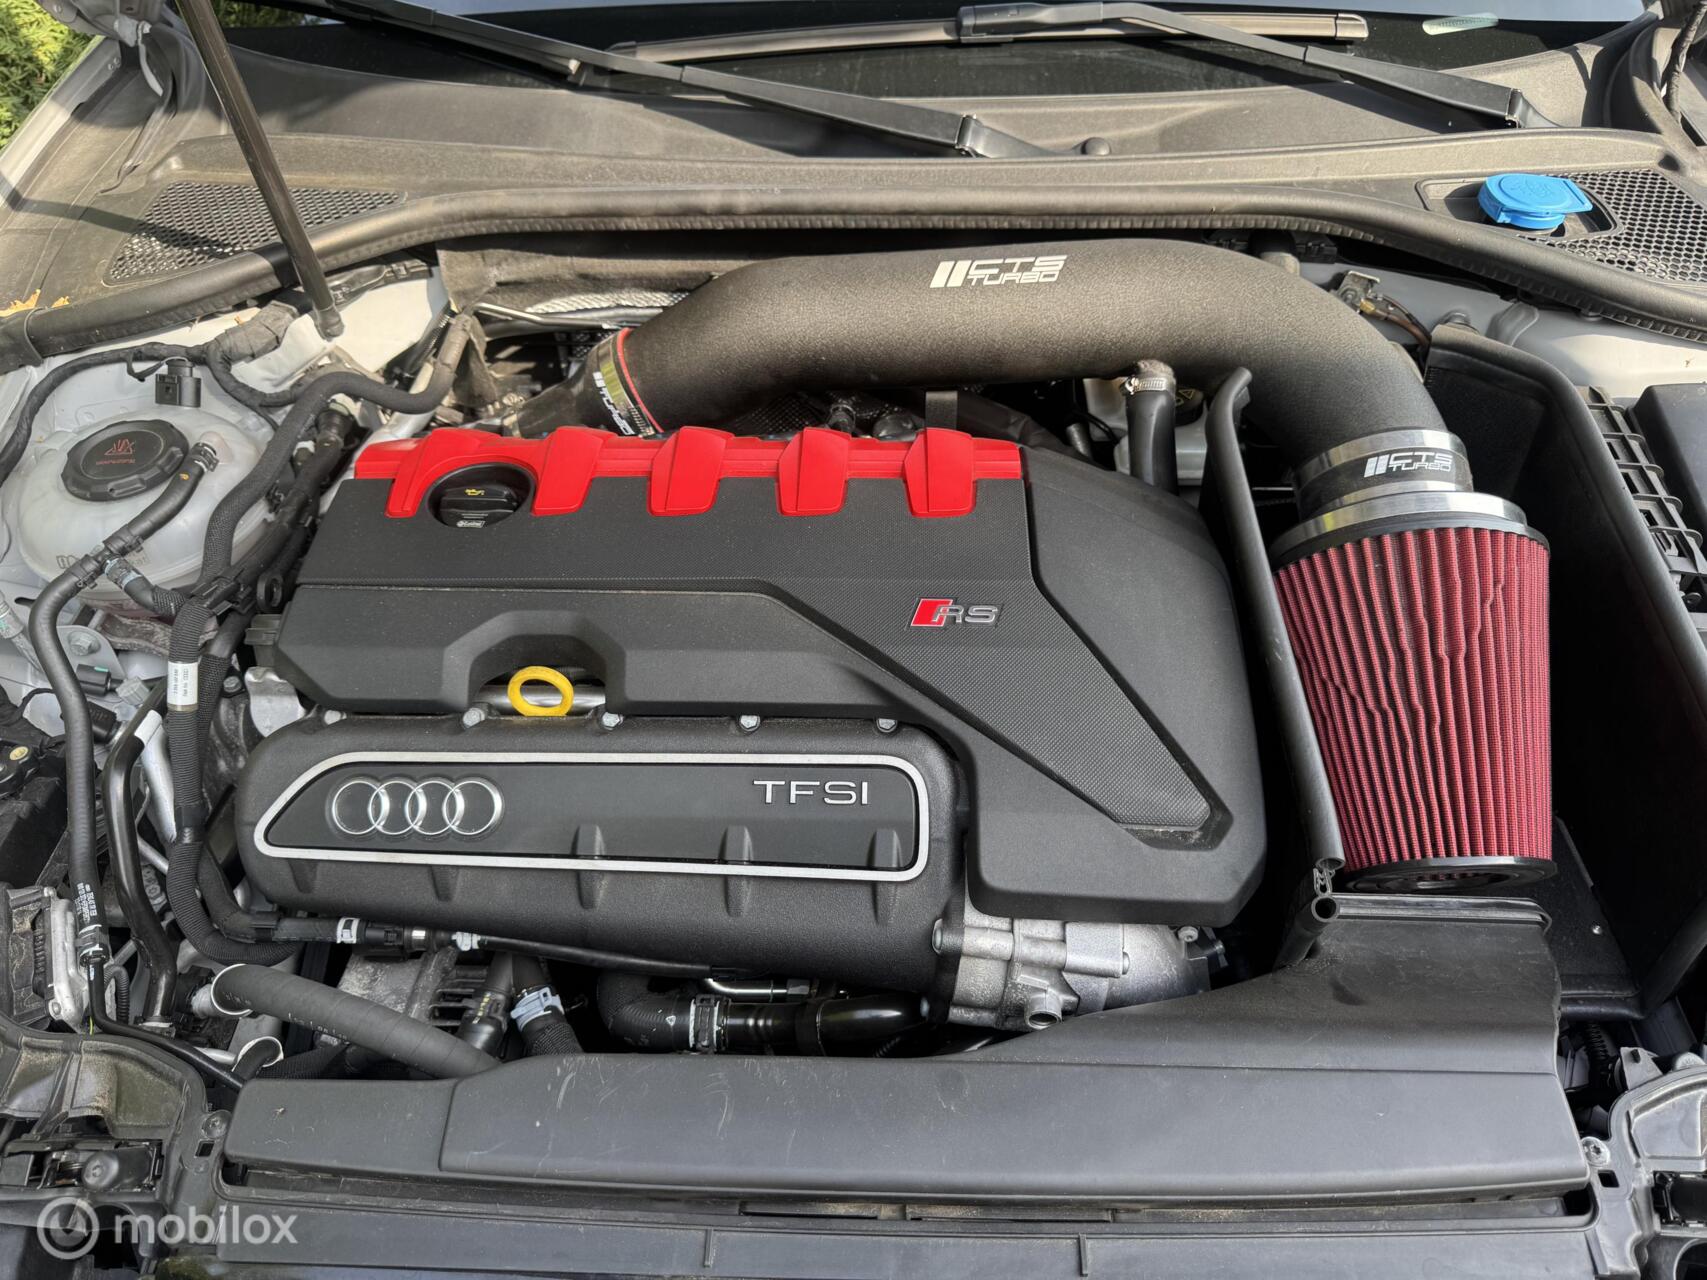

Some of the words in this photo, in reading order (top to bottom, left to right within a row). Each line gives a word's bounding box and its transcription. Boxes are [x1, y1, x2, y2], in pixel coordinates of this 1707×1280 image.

[968, 255, 1067, 275] CTS
[967, 270, 1060, 286] TURBO
[1389, 452, 1453, 465] CTS
[1389, 462, 1452, 473] TURBO
[931, 604, 999, 624] RS
[753, 780, 869, 805] TFSI
